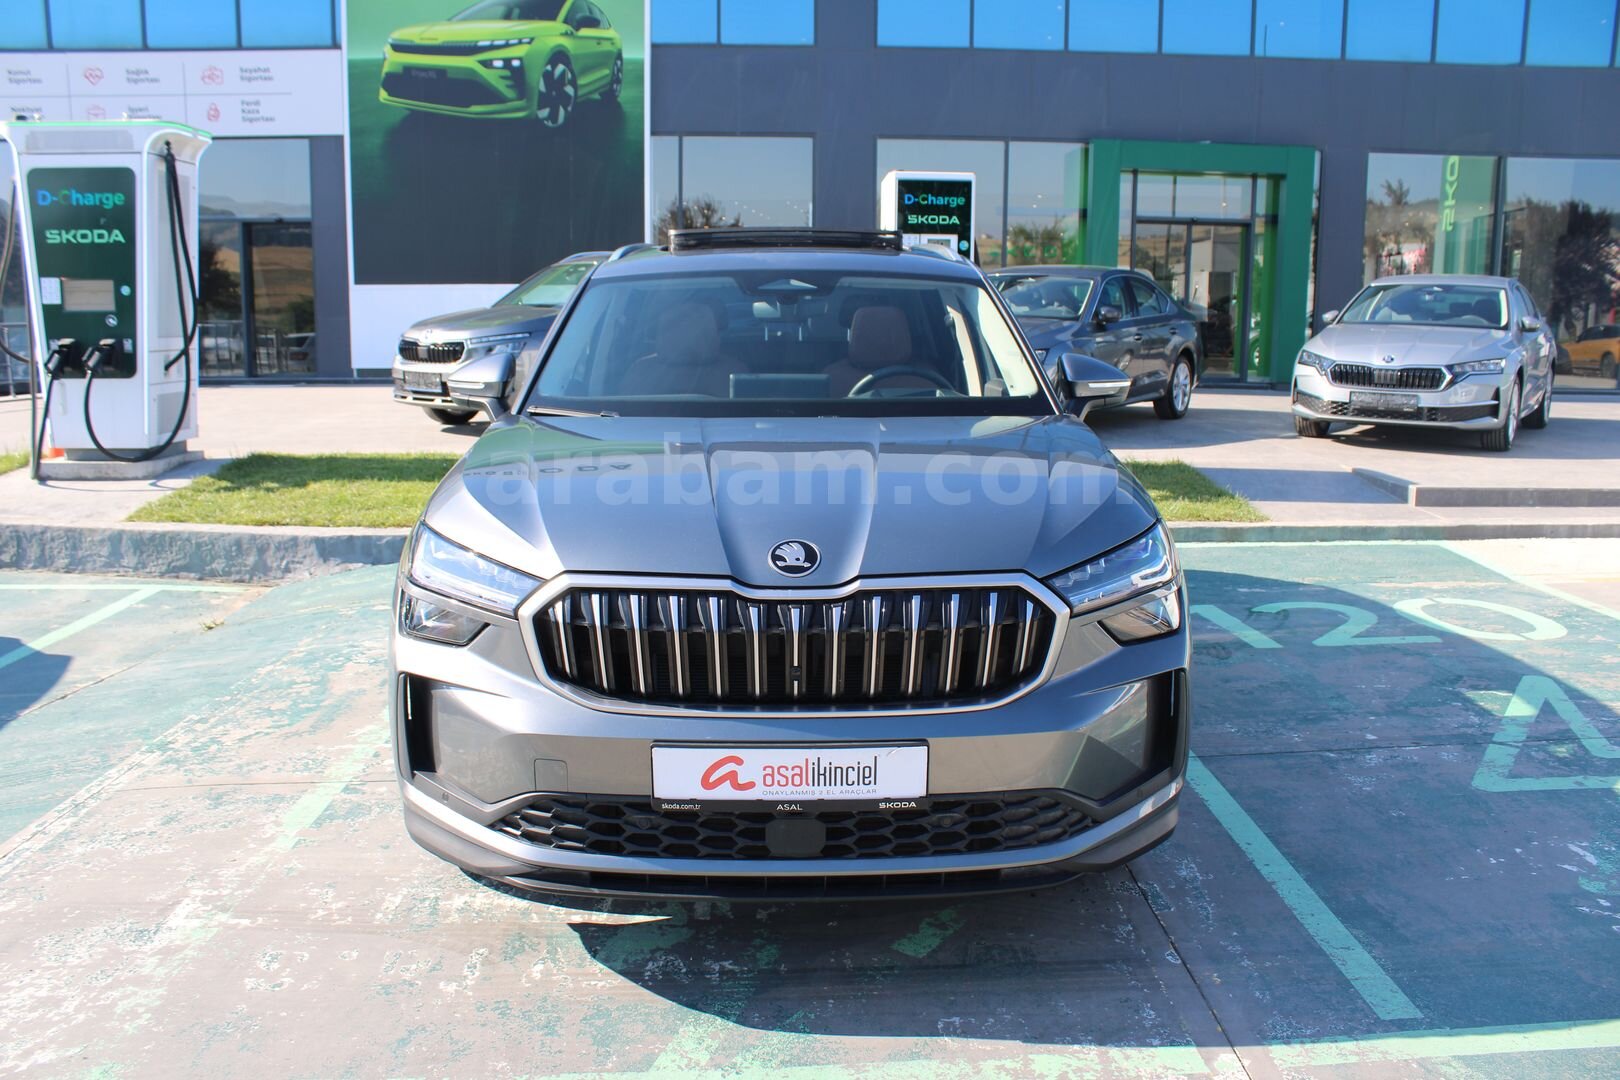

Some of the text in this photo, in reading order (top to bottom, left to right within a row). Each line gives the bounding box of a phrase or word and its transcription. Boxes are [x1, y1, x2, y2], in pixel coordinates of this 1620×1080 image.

[36, 188, 126, 210] D-Charge
[904, 194, 966, 208] D-Charge
[762, 755, 879, 788] asalikinciel
[661, 803, 701, 811] skoda.com.tr
[776, 803, 803, 811] ASAL
